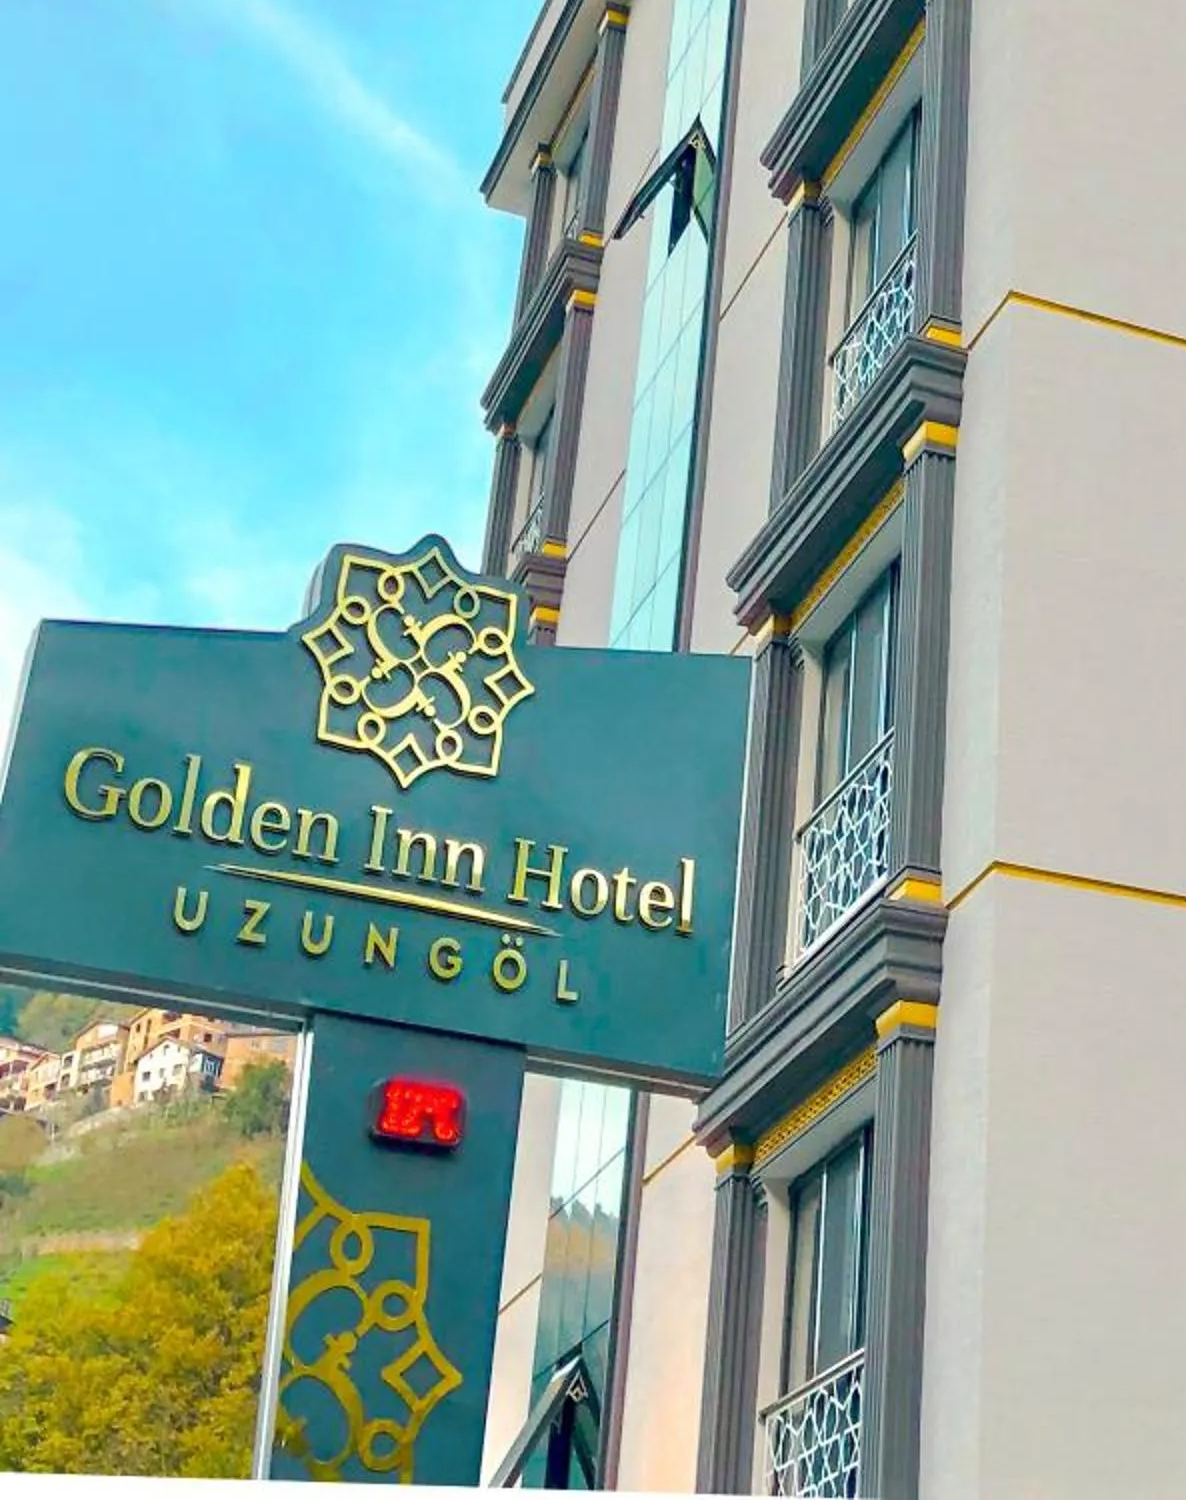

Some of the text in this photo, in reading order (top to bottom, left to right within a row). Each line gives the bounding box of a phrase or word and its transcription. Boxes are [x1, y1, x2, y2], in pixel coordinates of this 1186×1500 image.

[64, 747, 696, 936] Golden Inn Hotel
[174, 886, 579, 1002] UZUNGÖL
